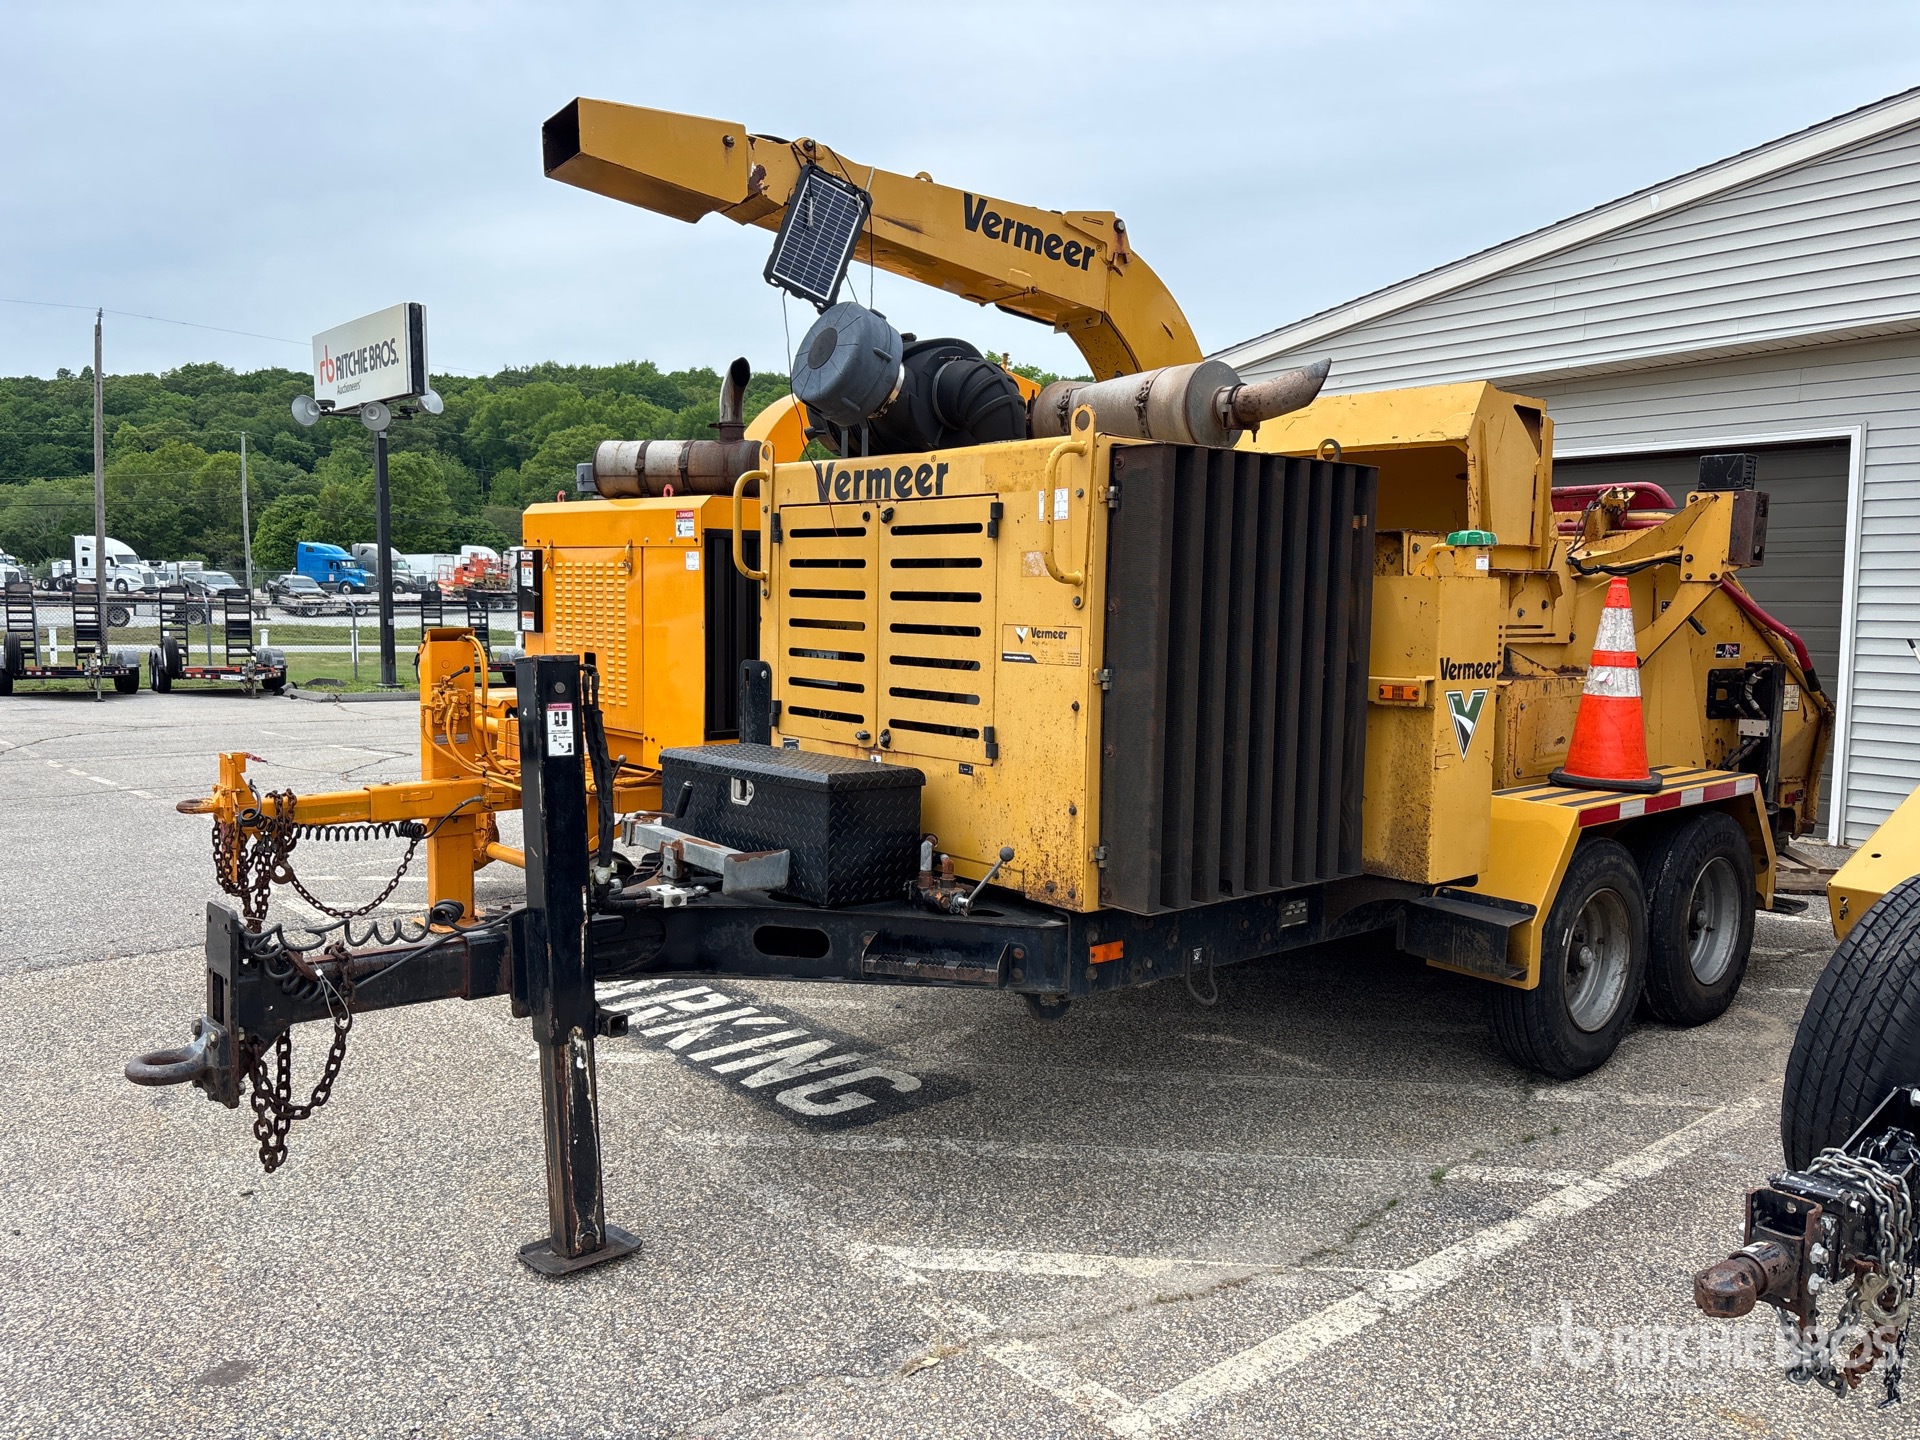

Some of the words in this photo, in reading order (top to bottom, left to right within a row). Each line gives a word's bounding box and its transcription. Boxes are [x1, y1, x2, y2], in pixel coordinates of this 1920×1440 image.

[964, 192, 1096, 271] Vermeer
[320, 345, 335, 385] rb
[336, 347, 368, 381] RITCHIE
[369, 338, 399, 371] BROS.
[815, 462, 949, 502] Vermeer
[1031, 627, 1068, 640] Vermeer
[1440, 657, 1498, 680] Vermeer
